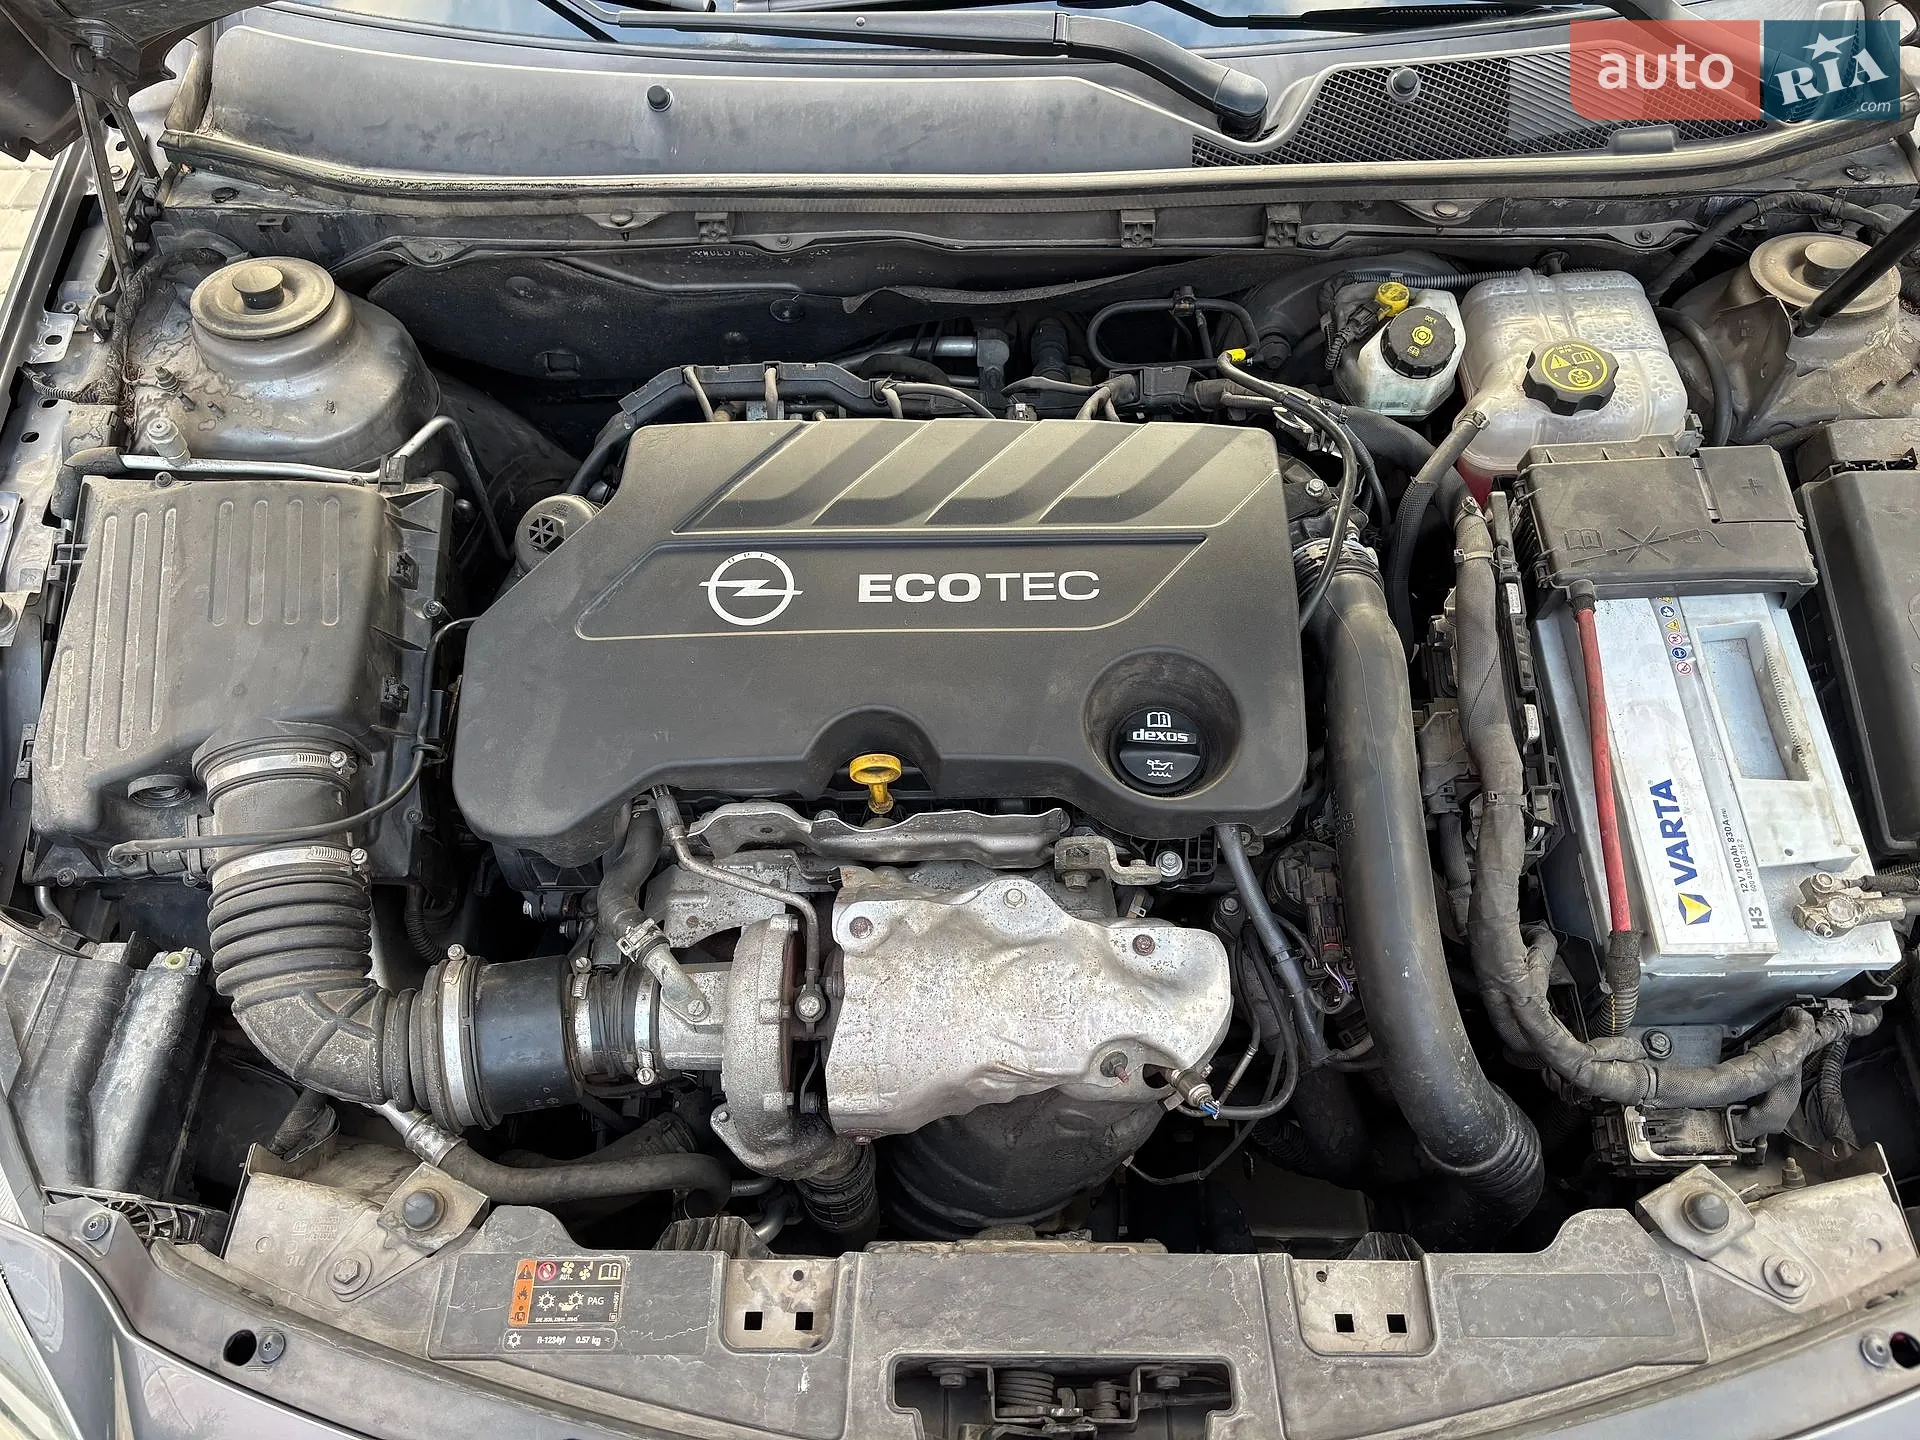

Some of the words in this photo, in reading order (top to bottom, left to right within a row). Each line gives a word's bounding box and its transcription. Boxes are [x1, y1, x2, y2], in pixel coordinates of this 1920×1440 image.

[858, 570, 1100, 603] ECOTEC
[1133, 729, 1189, 742] dexos
[1650, 778, 1698, 886] VARTA
[1730, 845, 1744, 874] 100Ah
[1738, 876, 1749, 894] 12V
[1749, 906, 1768, 929] H3
[587, 1296, 605, 1306] PAG
[537, 1336, 566, 1346] R-1234yf
[575, 1336, 590, 1344] 0.57
[591, 1336, 601, 1346] kg
